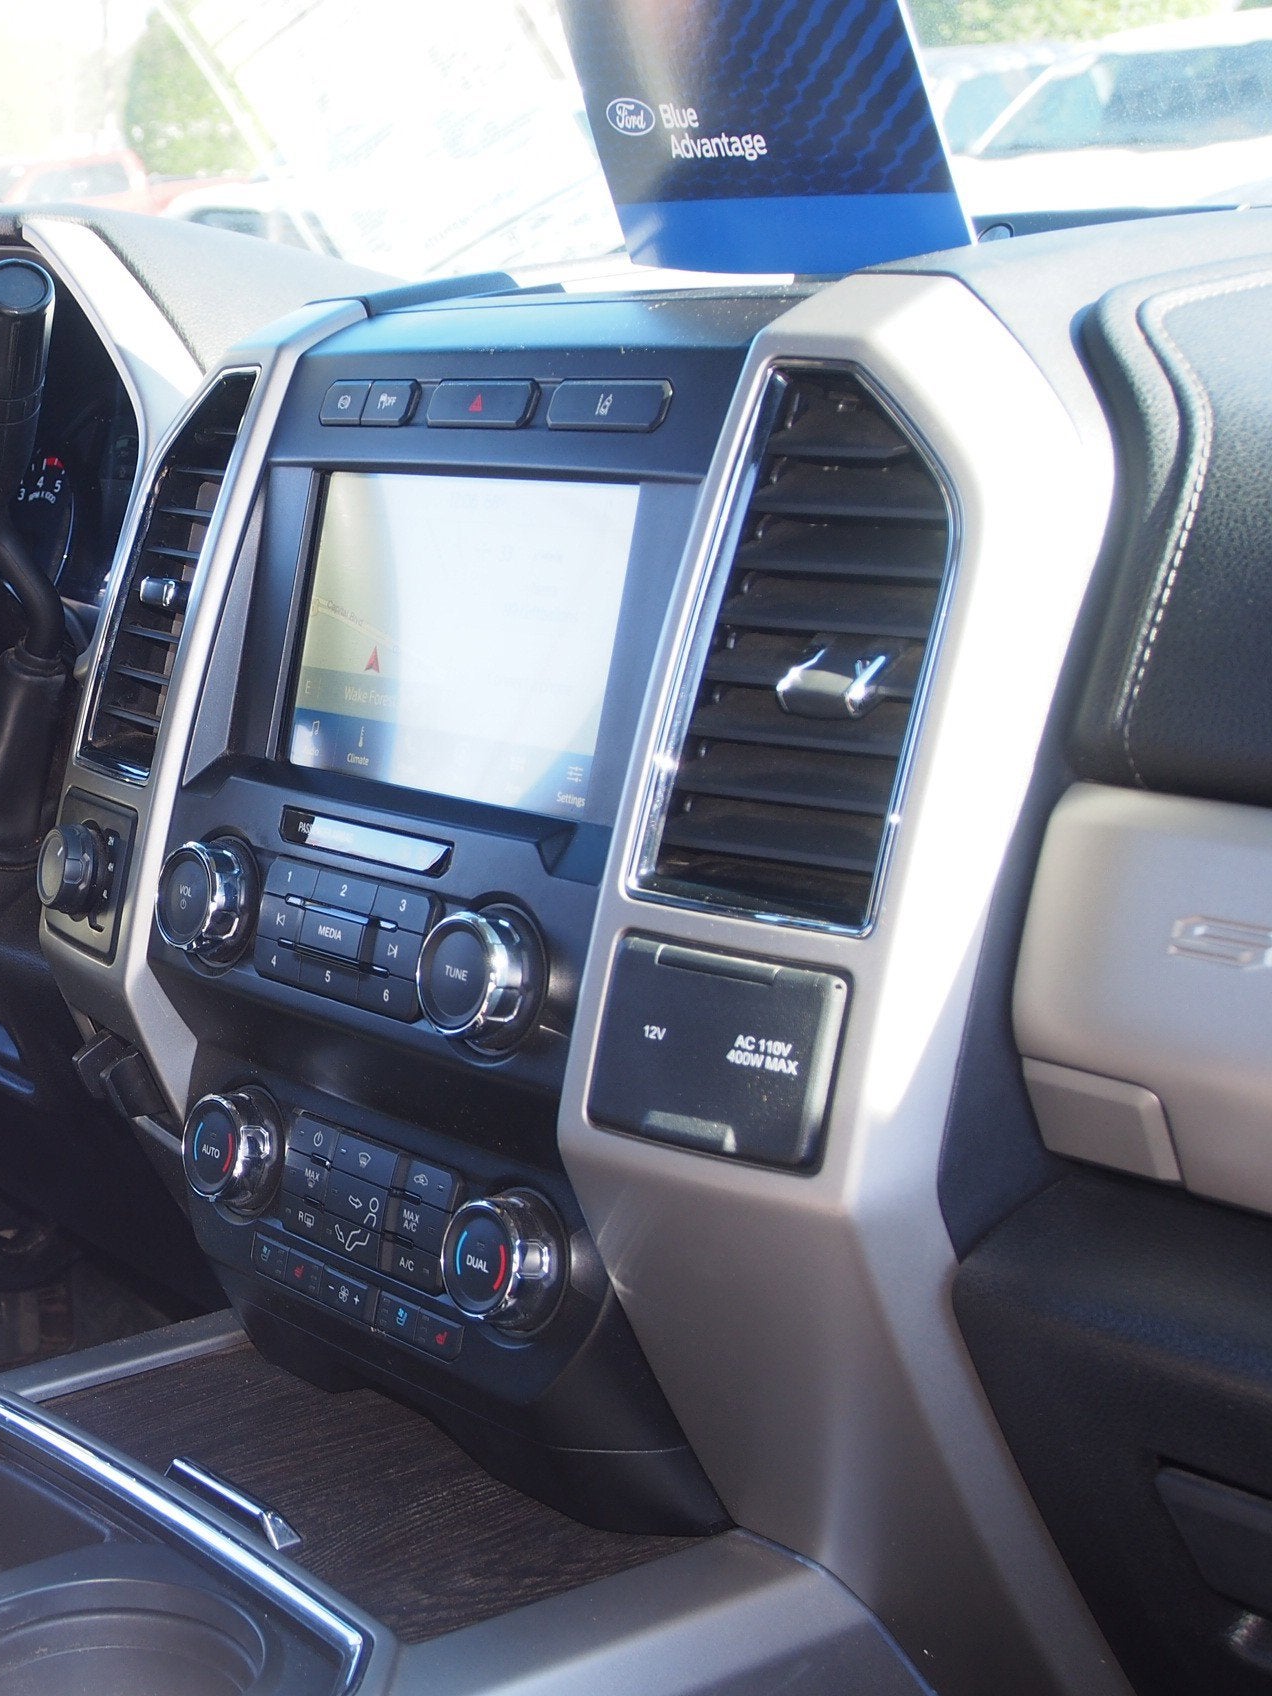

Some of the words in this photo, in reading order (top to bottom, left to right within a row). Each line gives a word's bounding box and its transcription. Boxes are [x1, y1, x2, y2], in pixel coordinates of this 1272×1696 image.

[658, 104, 699, 129] Blue
[671, 132, 768, 161] Advantage
[37, 476, 44, 488] 4
[53, 479, 62, 492] 5
[17, 488, 26, 501] 3
[347, 752, 370, 766] Climate
[557, 791, 586, 808] Settings
[287, 871, 293, 883] 1
[179, 884, 192, 898] VOL
[339, 884, 348, 897] 2
[399, 899, 407, 912] 3
[317, 925, 343, 942] MEDIA
[271, 955, 277, 968] 4
[324, 970, 332, 983] 5
[445, 965, 469, 981] TUNE
[383, 988, 390, 1002] 6
[642, 1024, 667, 1041] 12V
[733, 1034, 757, 1051] AC
[757, 1038, 793, 1058] 110V
[725, 1048, 765, 1069] 400W
[764, 1055, 799, 1077] MAX
[201, 1143, 221, 1159] AUTO
[304, 1168, 321, 1182] MAX
[298, 1211, 304, 1222] R
[402, 1209, 420, 1224] MAX
[402, 1221, 418, 1233] A/C
[399, 1257, 415, 1272] A/C
[465, 1254, 490, 1274] DUAL
